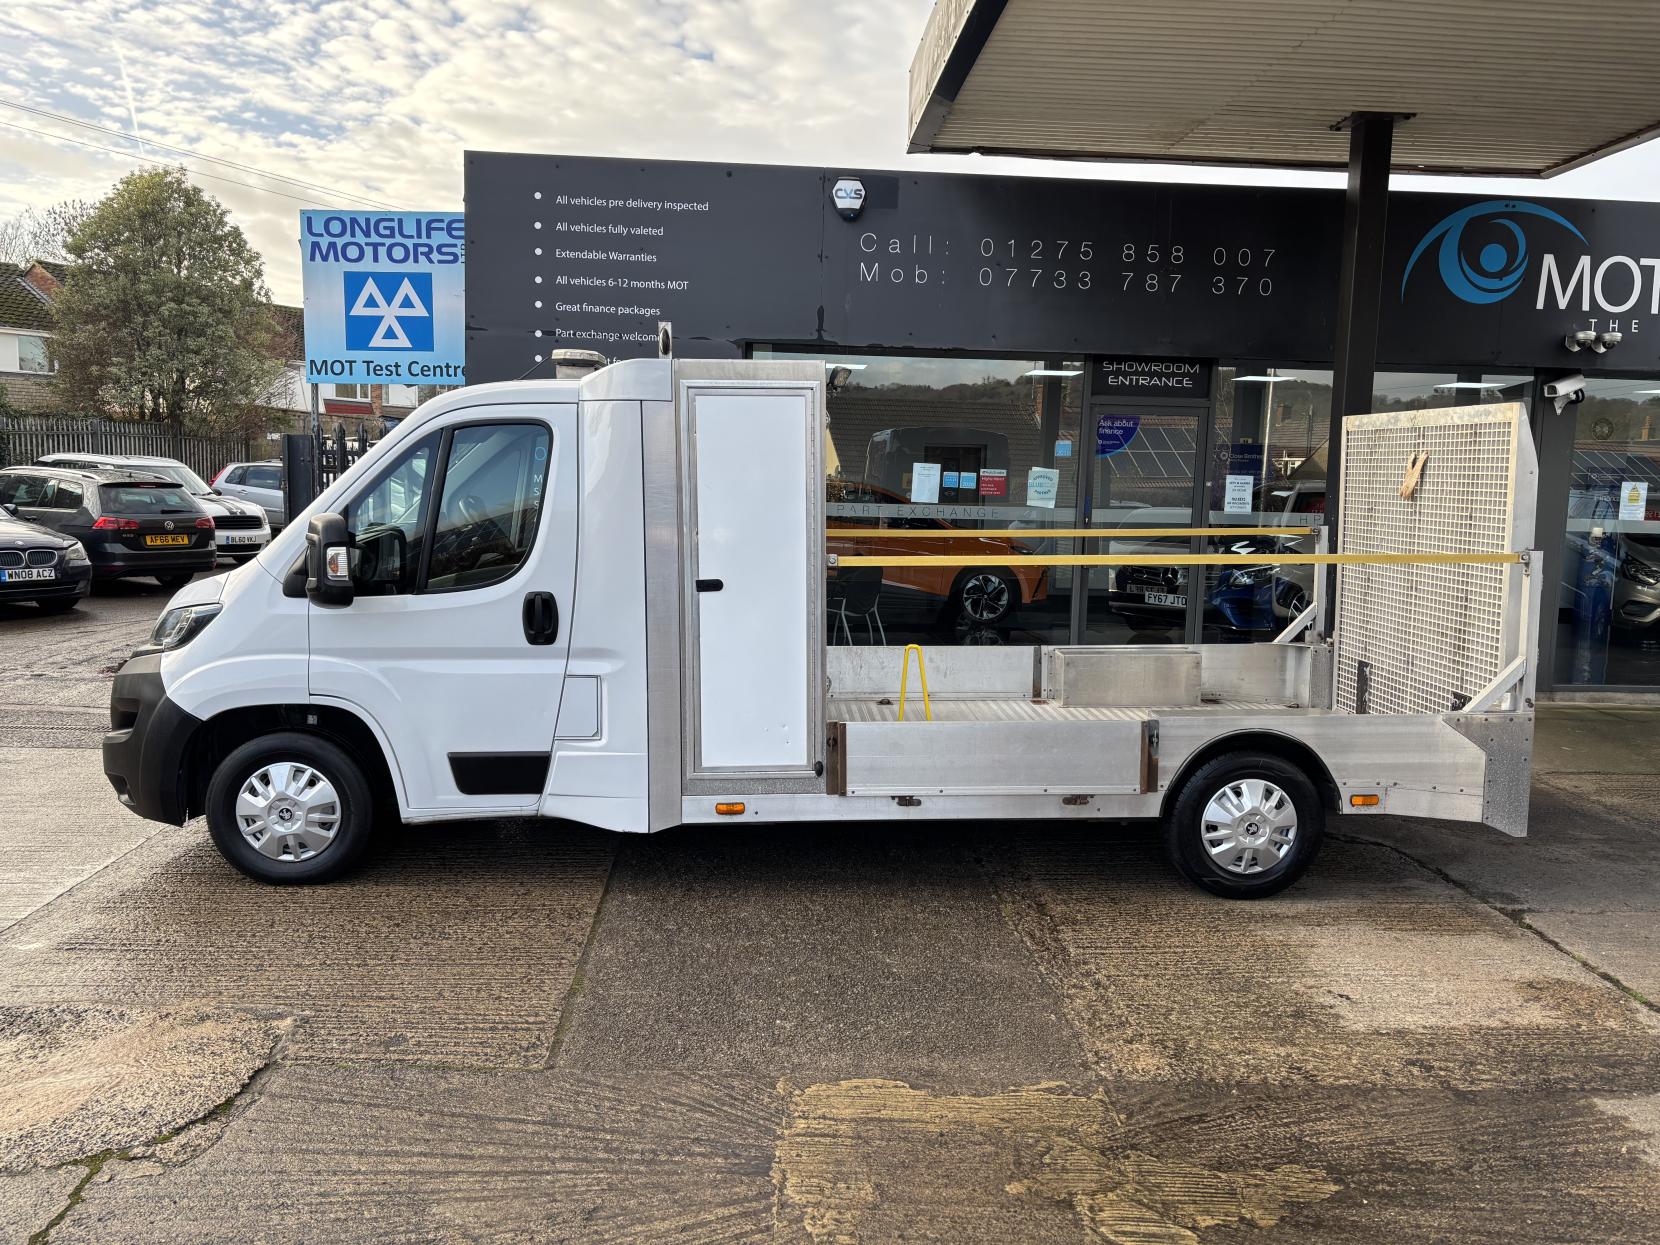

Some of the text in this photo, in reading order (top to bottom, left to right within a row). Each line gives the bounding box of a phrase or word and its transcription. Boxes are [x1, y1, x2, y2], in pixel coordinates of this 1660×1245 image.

[555, 195, 709, 212] All vehicles pre delivery inspected
[306, 215, 465, 240] LONGLIFE
[555, 222, 664, 236] All vehicles fully valeted
[309, 241, 460, 265] MOTORS
[555, 249, 657, 262] Extendable Warranties
[860, 232, 1276, 267] Call: 01275 858 007
[555, 275, 689, 290] All vehicles 6-12 months MOT
[860, 262, 1272, 296] Mob: 07733 787 370
[555, 302, 661, 316] Great finance packages
[1588, 319, 1639, 333] THE
[555, 328, 574, 338] Part
[576, 330, 620, 342] exchange
[309, 359, 357, 376] MOT
[362, 360, 402, 377] Test
[1102, 361, 1200, 374] SHOWROOM
[1108, 375, 1193, 387] ENTRANCE
[836, 504, 1001, 519] PART EXCHANGE
[150, 535, 170, 544] AF66
[7, 569, 54, 580] WN08 ACZ
[1147, 593, 1168, 604] FY67
